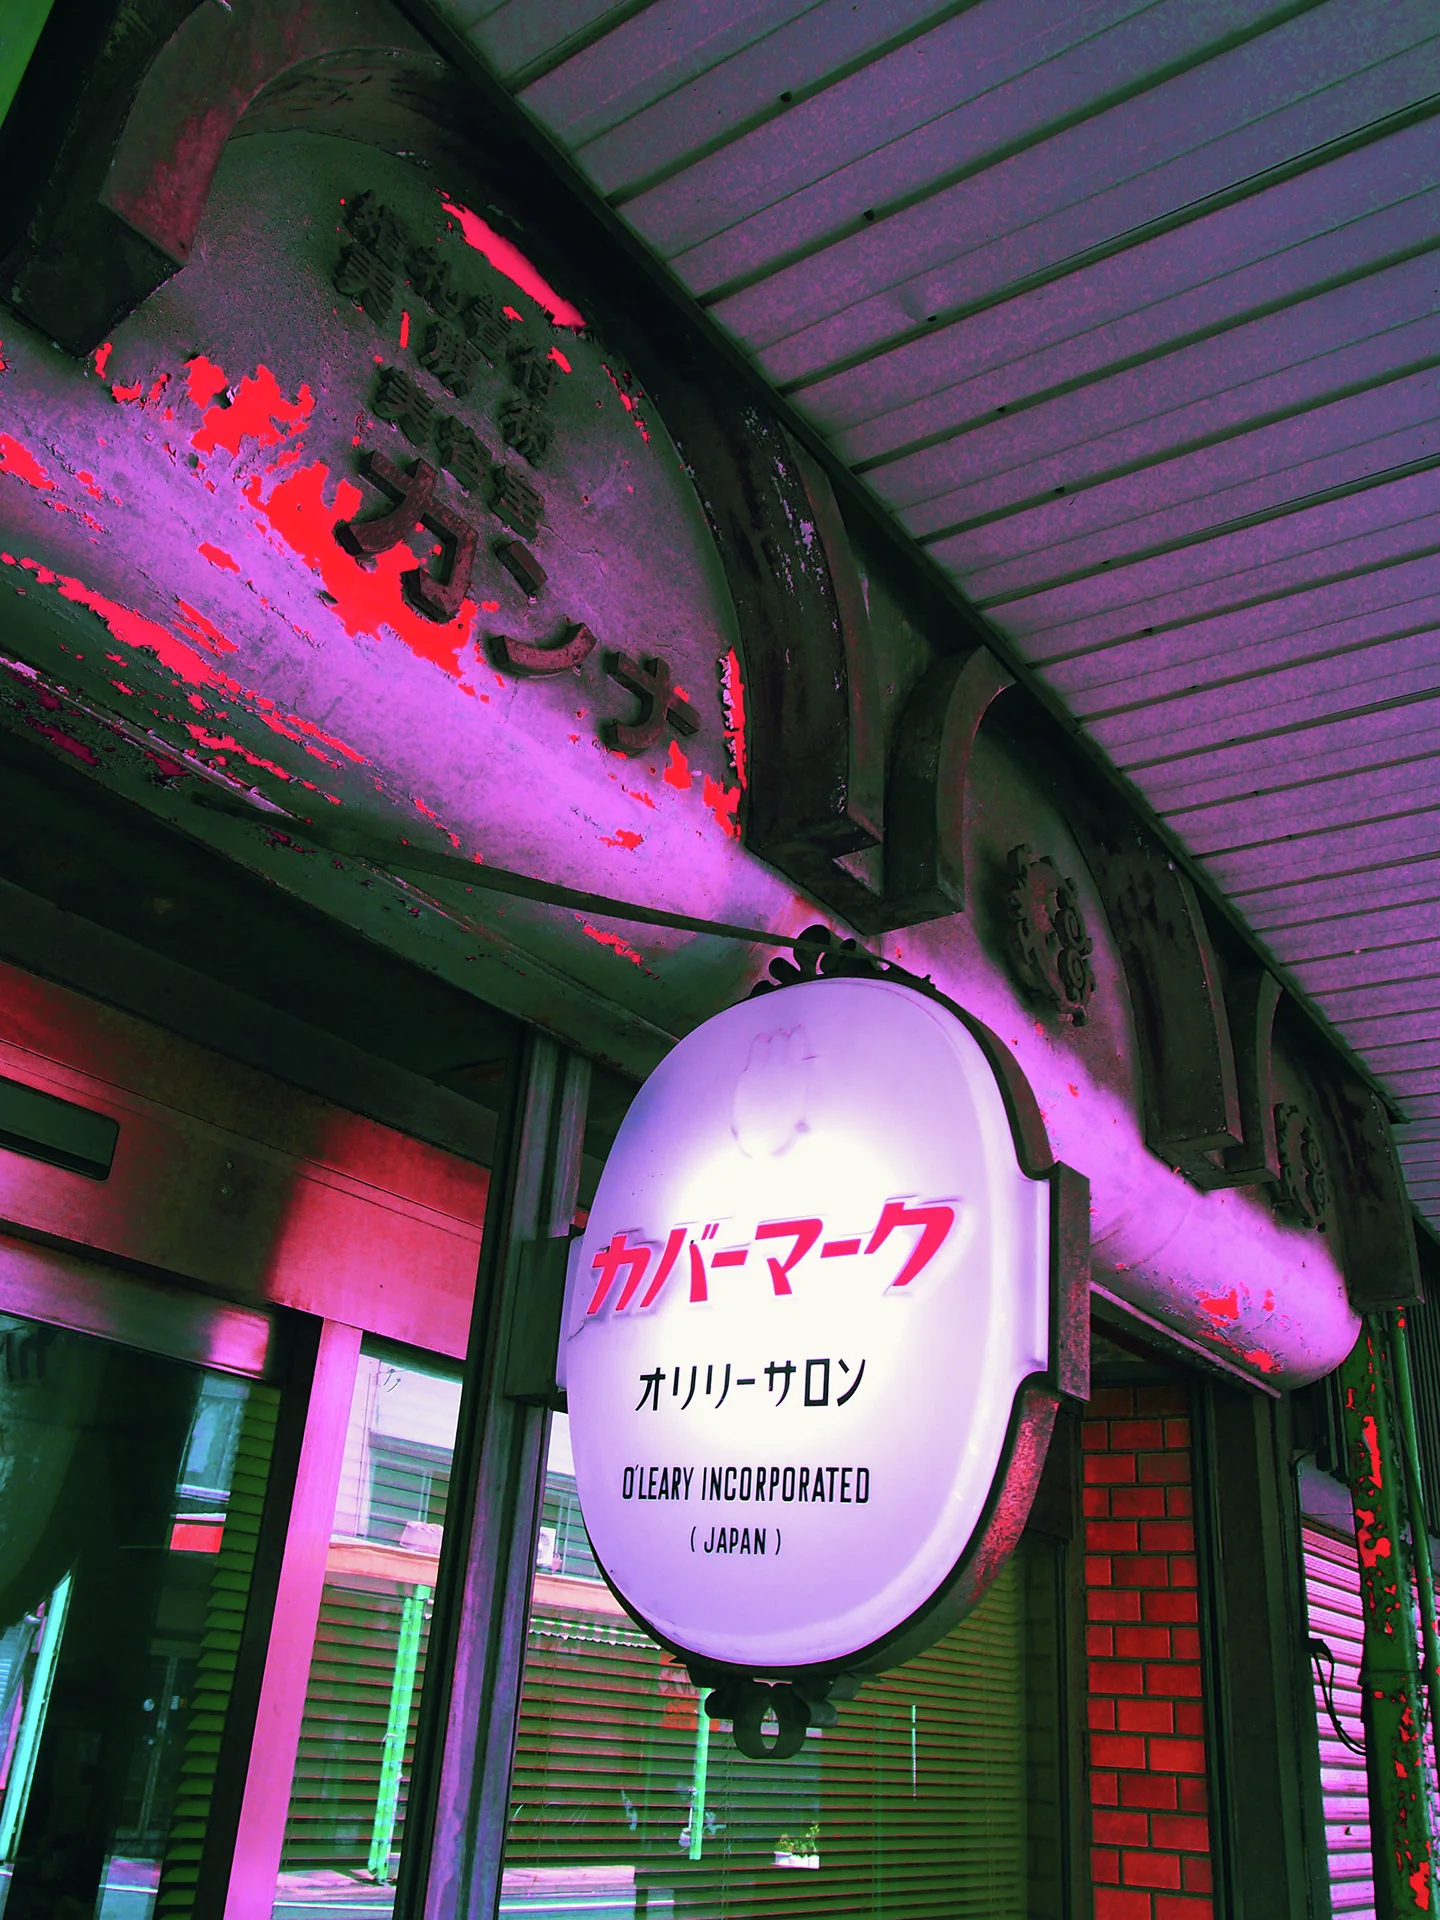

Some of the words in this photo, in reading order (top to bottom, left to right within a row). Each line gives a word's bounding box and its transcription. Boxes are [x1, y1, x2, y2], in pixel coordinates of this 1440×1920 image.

[371, 366, 545, 542] 美容室
[333, 451, 699, 757] カンナ
[587, 1202, 954, 1314] カバーマーク
[635, 1359, 865, 1411] オリリーサロン
[622, 1464, 694, 1501] O'LEARY
[702, 1467, 870, 1504] INCORPORATED
